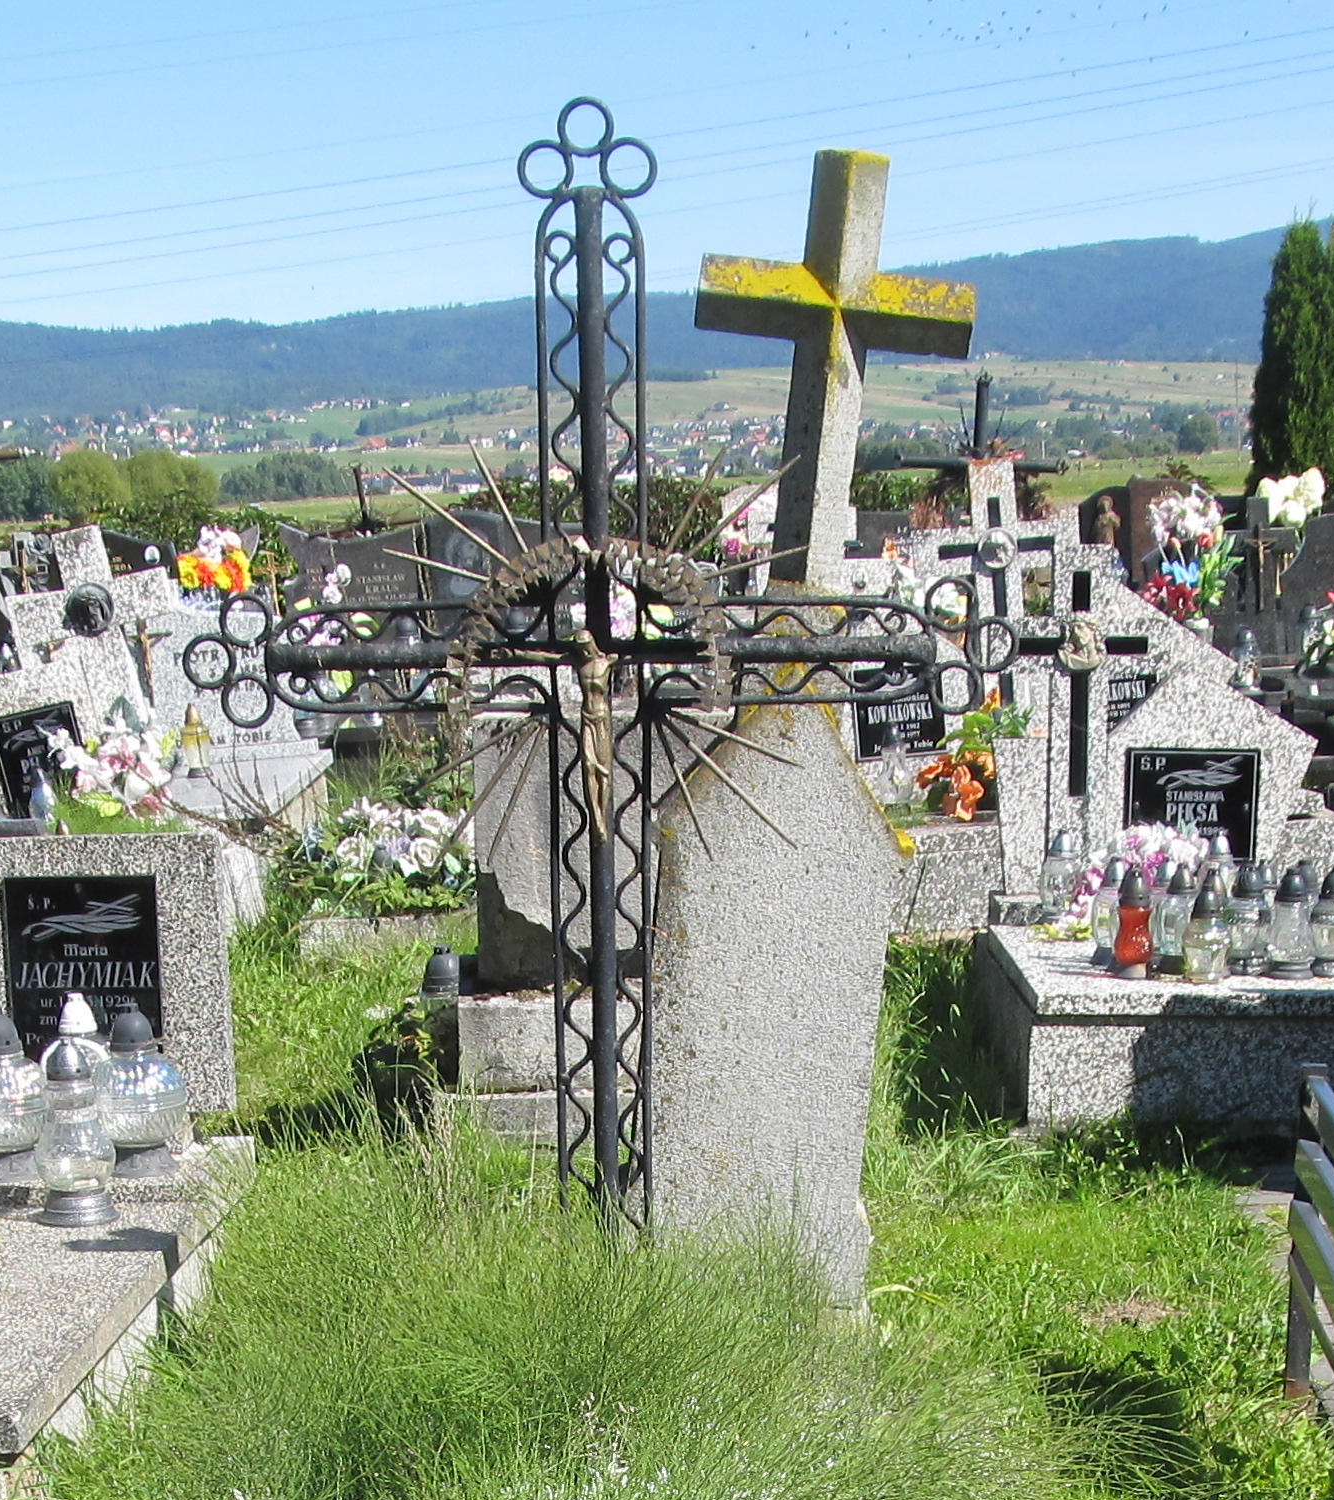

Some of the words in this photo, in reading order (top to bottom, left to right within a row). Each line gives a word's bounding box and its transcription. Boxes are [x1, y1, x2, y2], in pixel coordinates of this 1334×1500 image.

[173, 649, 221, 666] POTR
[1108, 679, 1146, 702] KOWSKI
[867, 701, 934, 725] KOWALKOWSKA
[63, 943, 109, 958] Maria
[15, 960, 156, 990] JACHYMIAK
